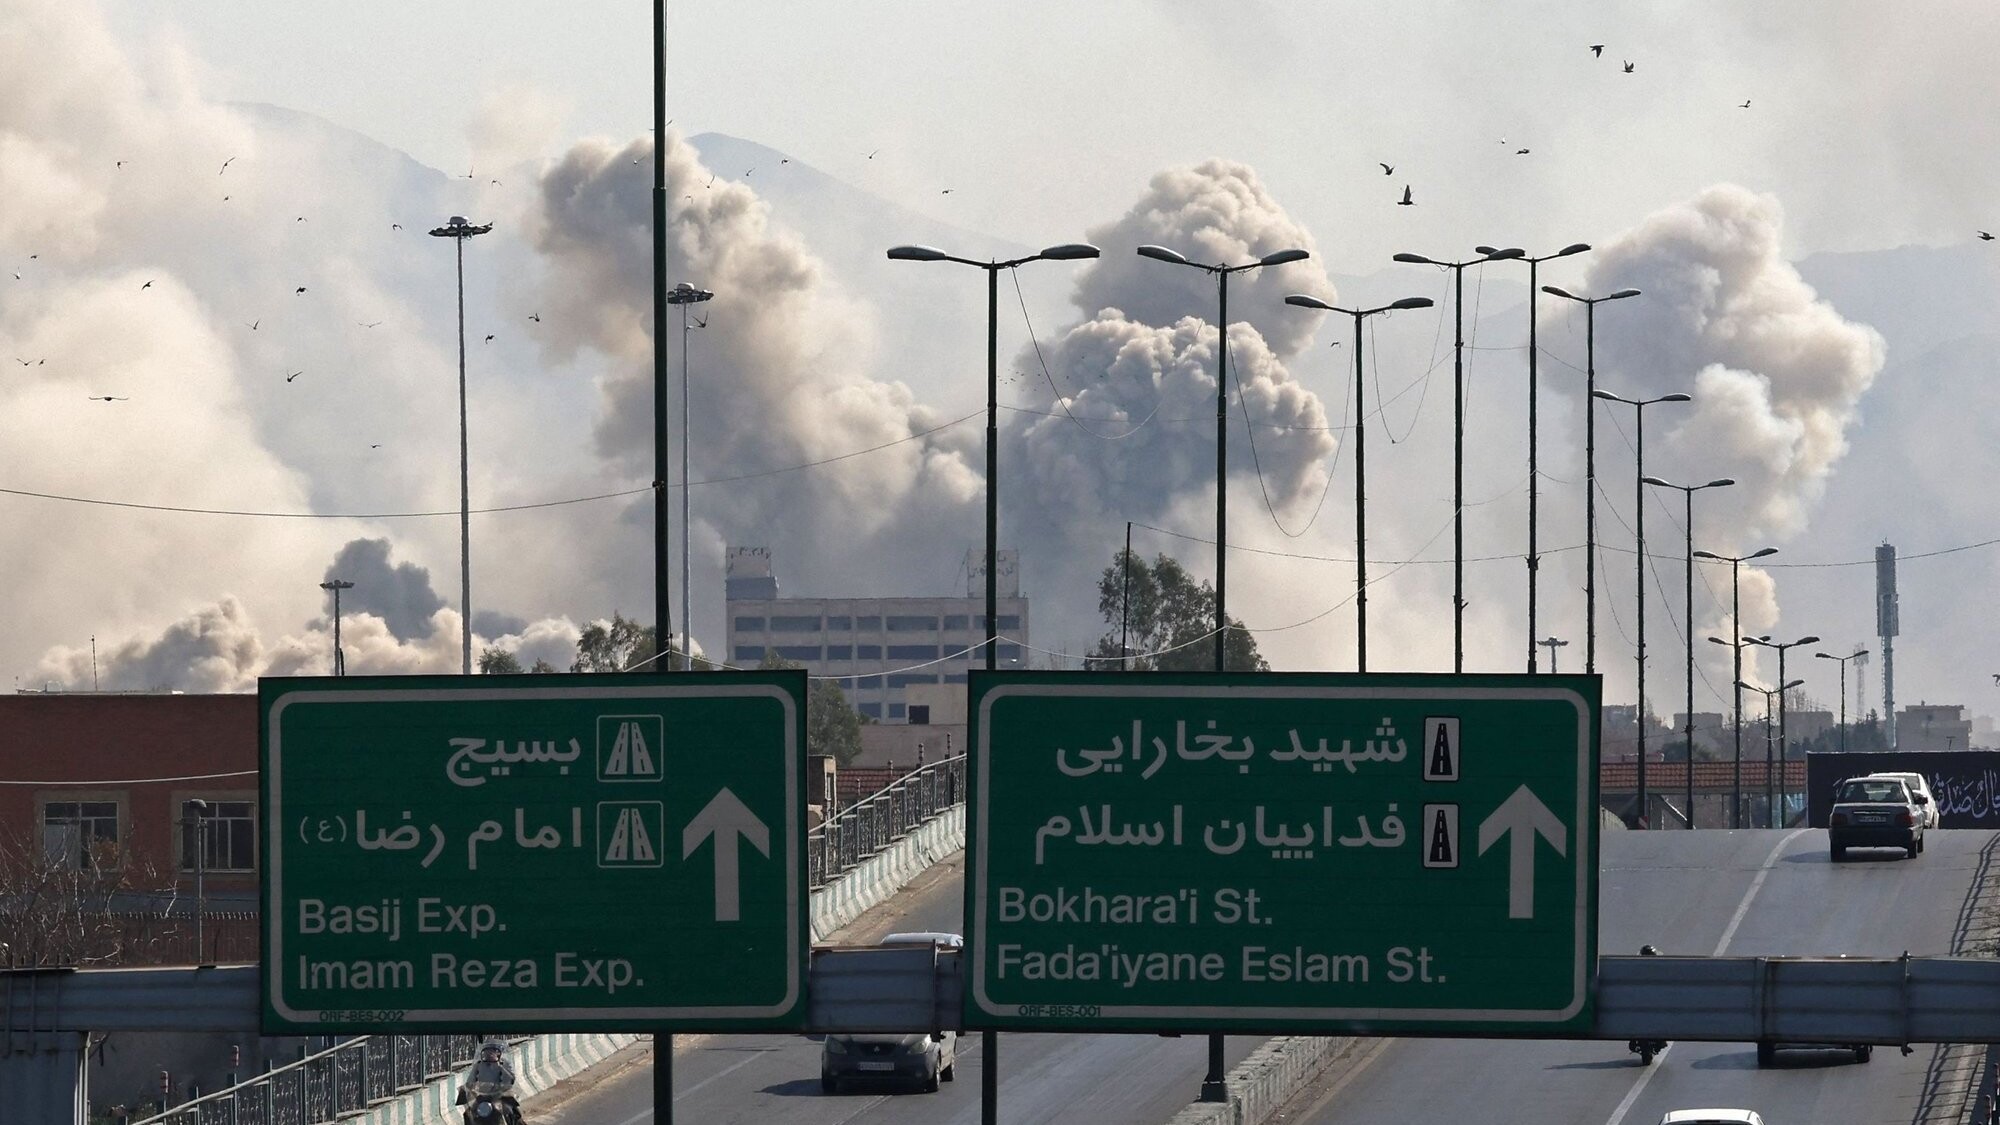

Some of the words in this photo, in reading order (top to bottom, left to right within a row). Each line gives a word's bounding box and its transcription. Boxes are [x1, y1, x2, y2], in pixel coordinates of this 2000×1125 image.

[446, 737, 581, 787] بسیج
[1056, 719, 1255, 780] بخارایی
[1269, 717, 1408, 774] شهید
[468, 807, 582, 870] امام
[1035, 804, 1183, 865] اسلام
[1203, 803, 1406, 859] فداییان
[299, 898, 400, 941] Basij
[418, 897, 506, 939] Exp.
[999, 886, 1197, 924] Bokhara'i
[1214, 888, 1272, 925] St.
[300, 955, 414, 990] Imam
[431, 953, 537, 988] Reza
[555, 952, 644, 994] Exp.
[998, 944, 1225, 988] Fada'iyane
[1242, 946, 1369, 982] Eslam
[1386, 946, 1446, 983] St.
